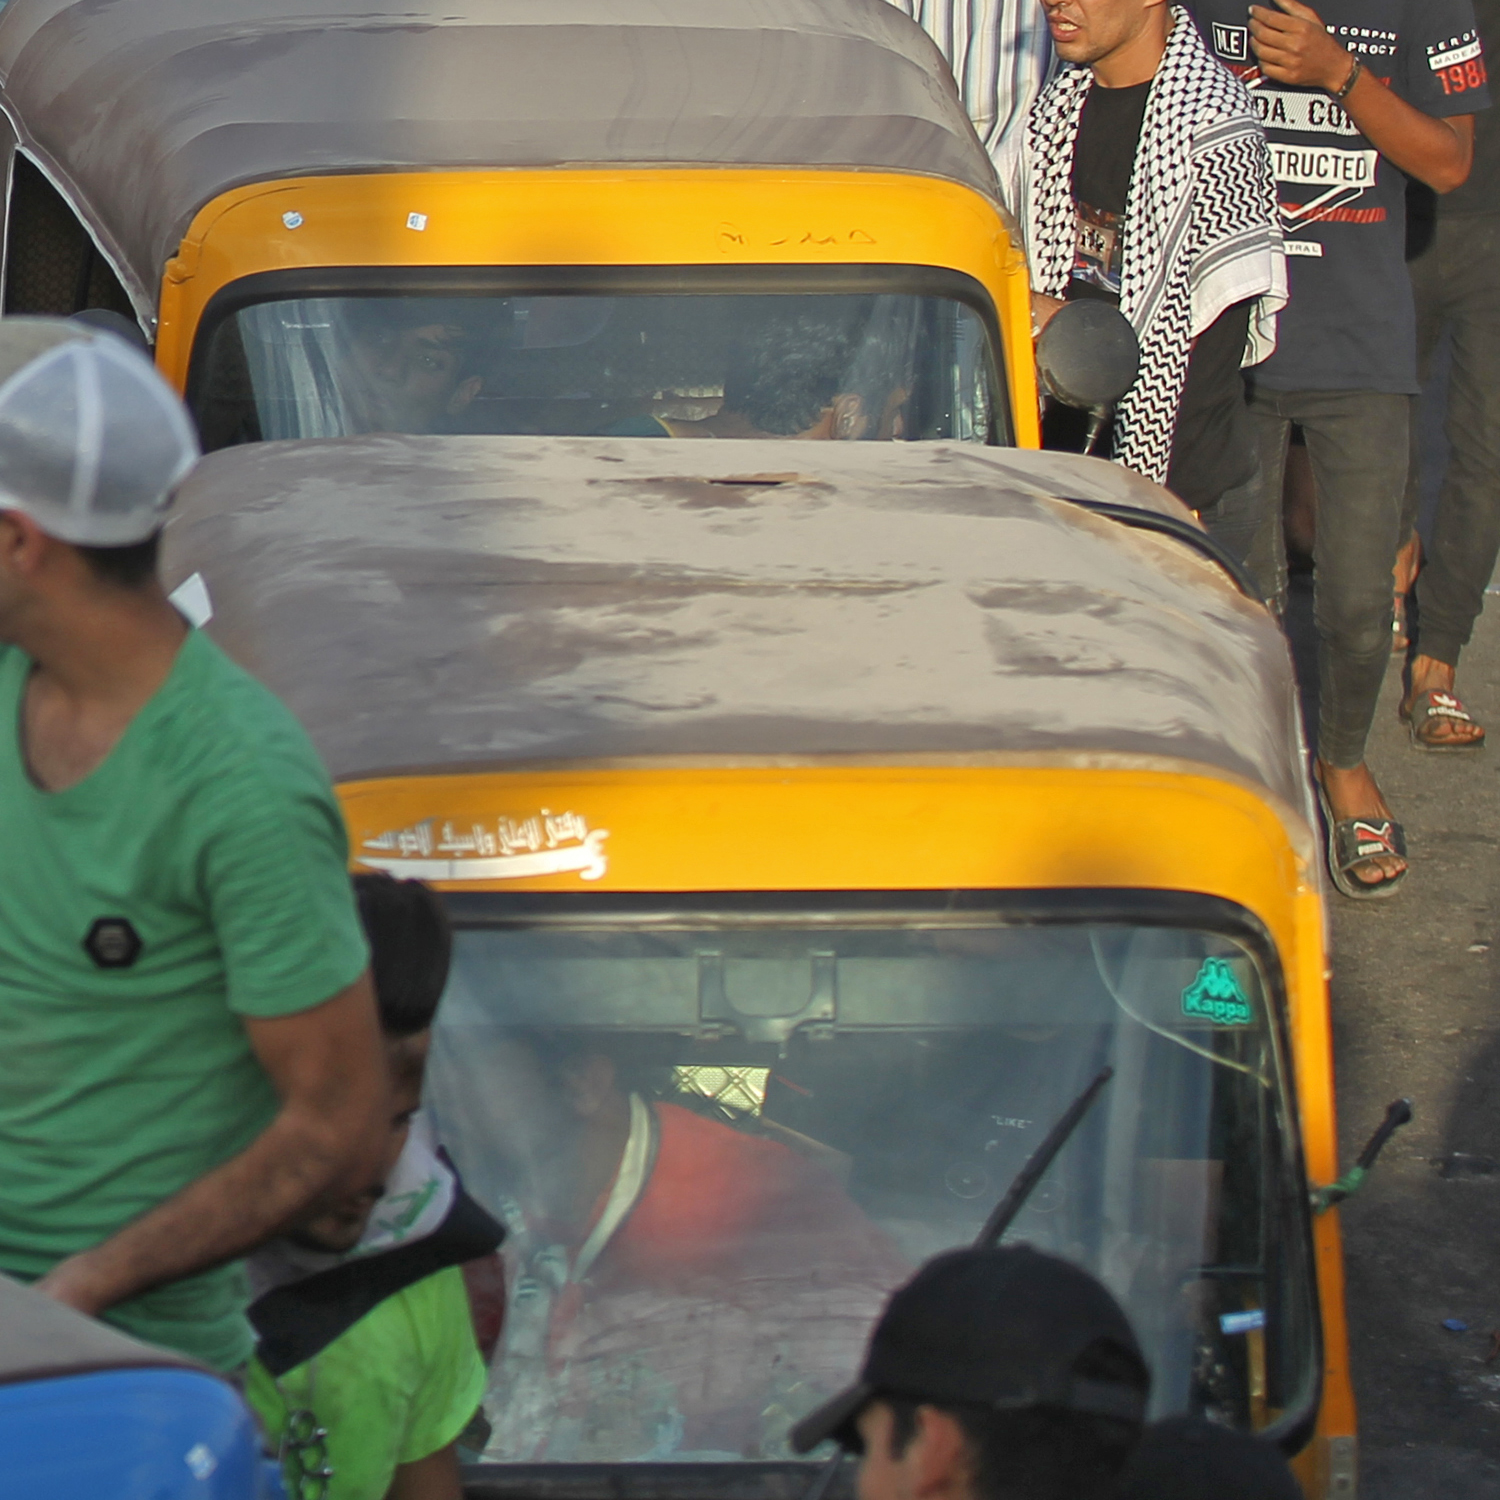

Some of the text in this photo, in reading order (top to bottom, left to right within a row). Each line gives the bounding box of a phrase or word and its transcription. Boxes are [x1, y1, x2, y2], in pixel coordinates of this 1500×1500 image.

[1339, 26, 1397, 42] COMPAN
[1276, 150, 1368, 181] TRUCTED
[1185, 992, 1249, 1021] Kappa
